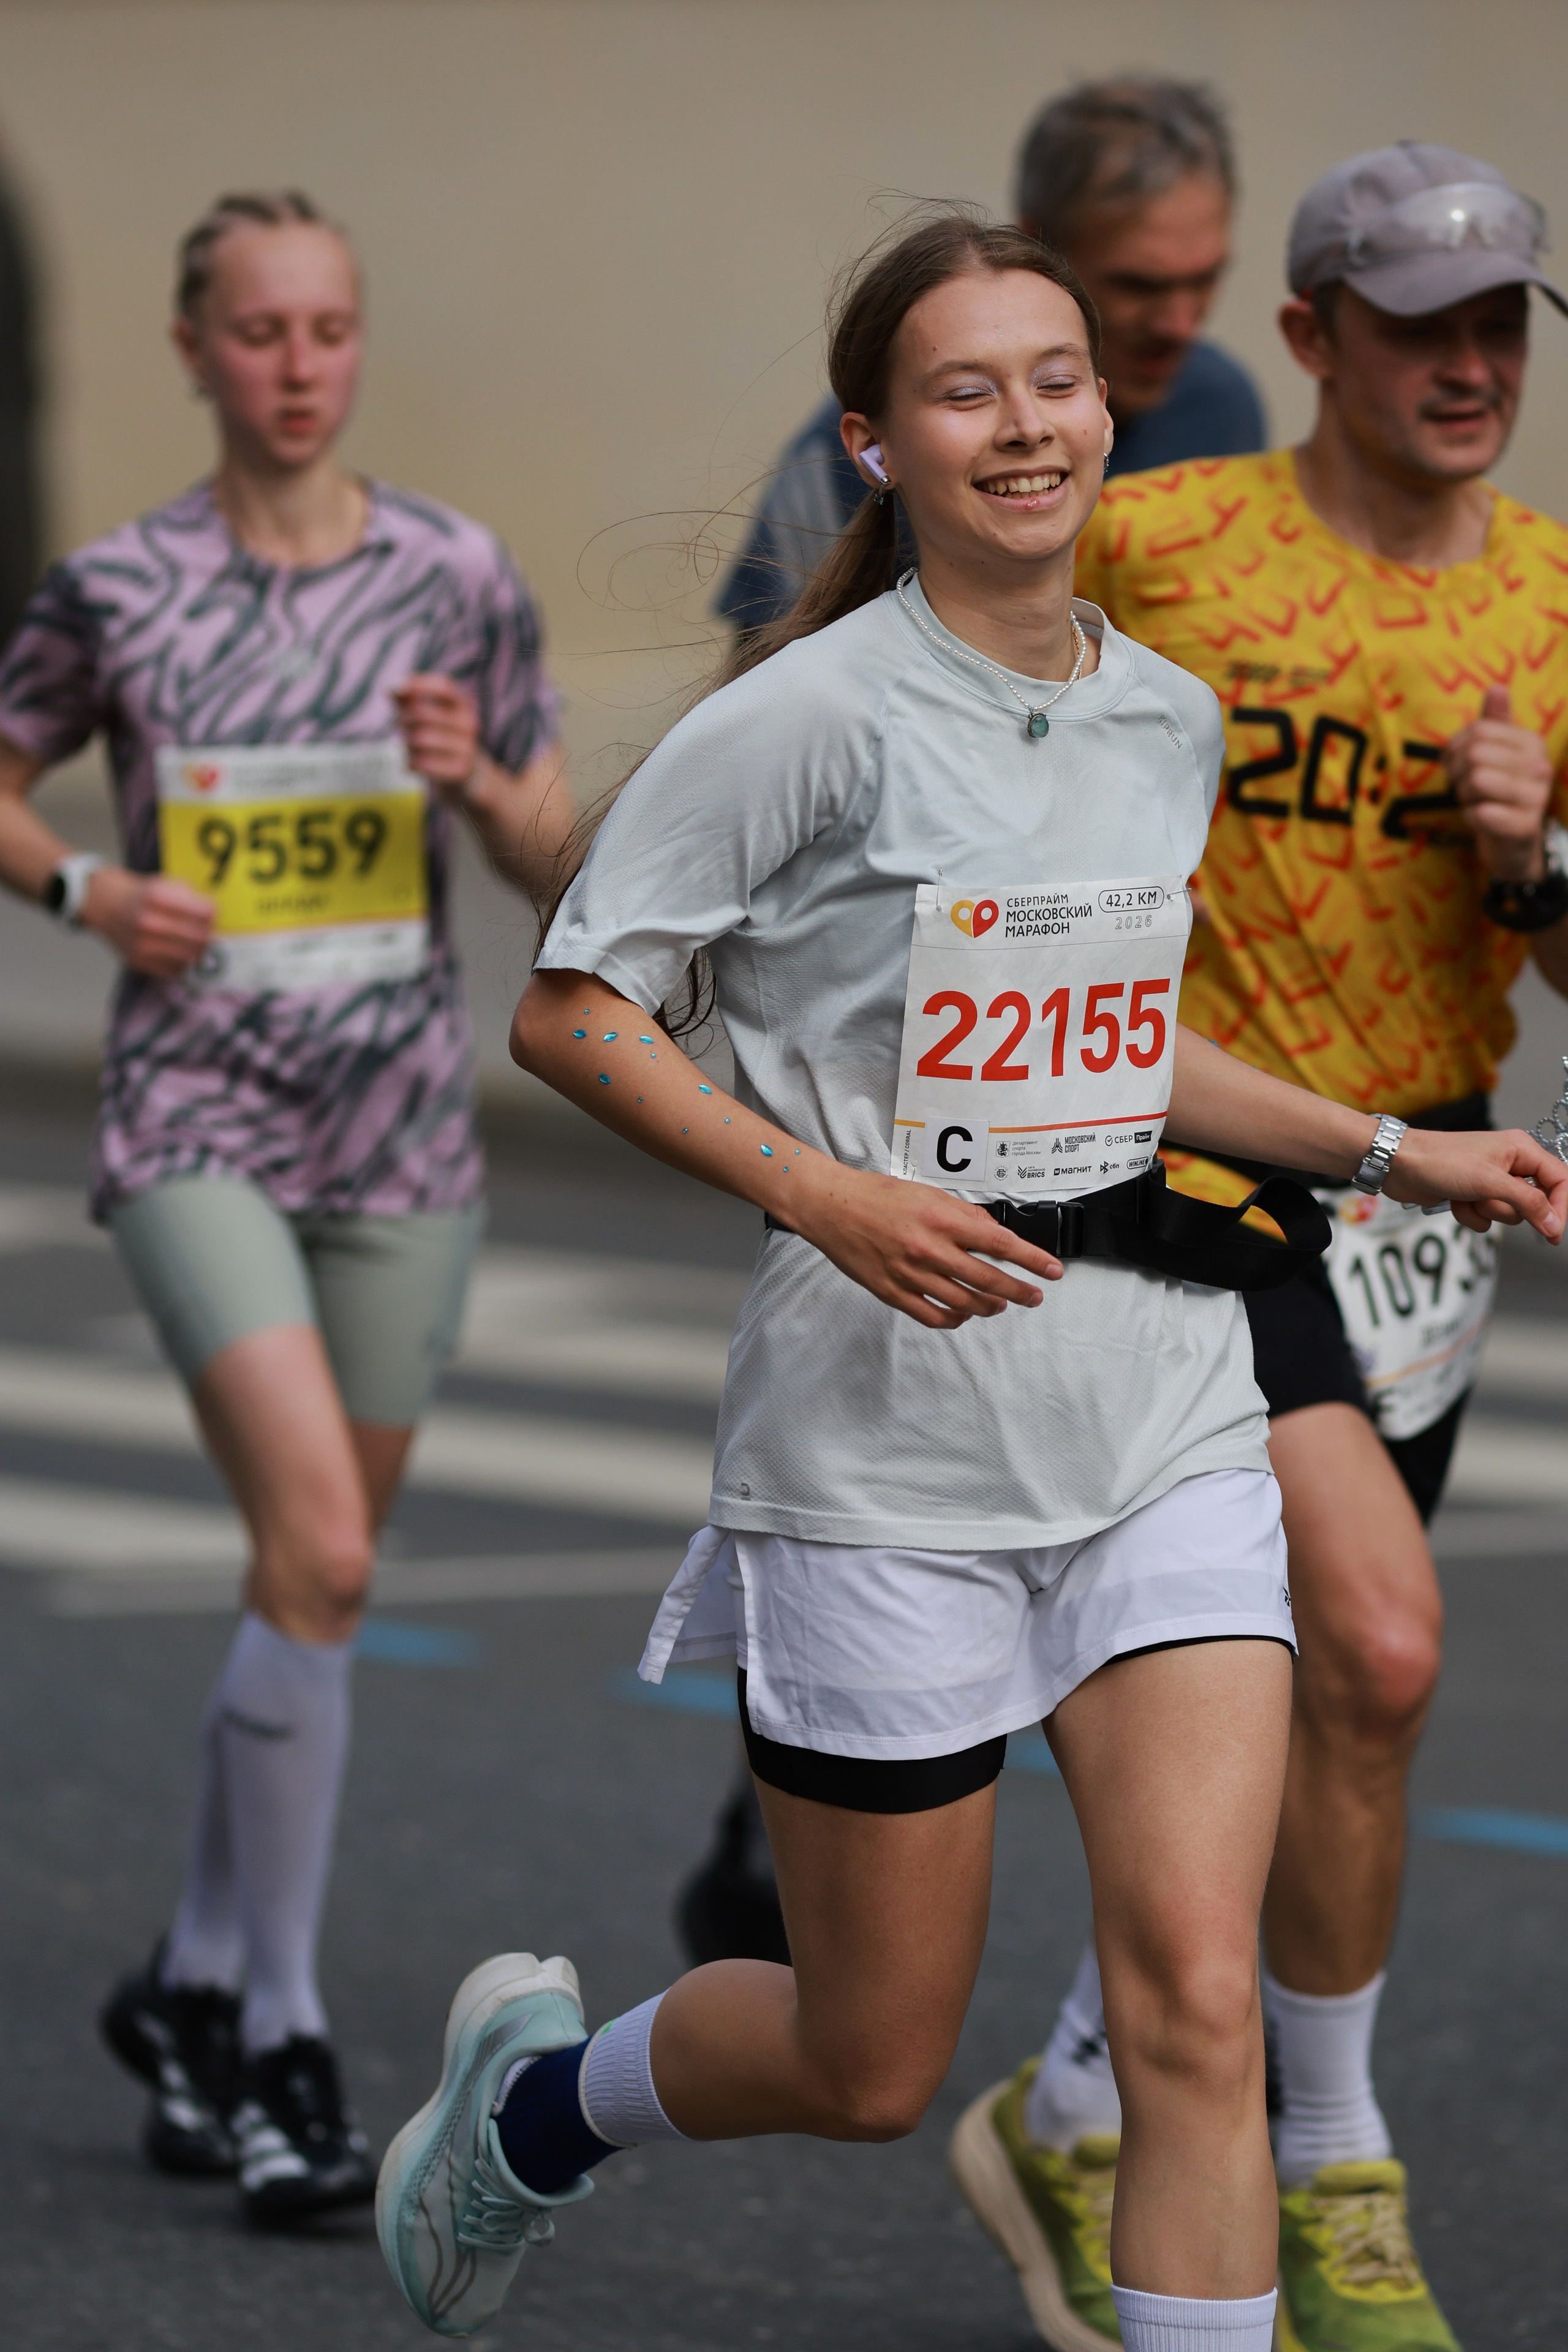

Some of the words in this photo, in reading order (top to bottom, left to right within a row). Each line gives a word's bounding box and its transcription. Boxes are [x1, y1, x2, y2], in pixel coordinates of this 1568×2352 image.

[1158, 715, 1183, 748] KIPRUN
[197, 809, 388, 887] 9559
[1007, 894, 1069, 907] СБЕРПРАЙМ
[1106, 893, 1133, 908] 42,2
[1138, 891, 1157, 905] КМ
[1006, 903, 1093, 923] МОСКОВСКИЙ
[1005, 922, 1070, 938] МАРАФОН
[1115, 914, 1152, 930] 2026
[916, 978, 1170, 1081] 22155
[1065, 1133, 1096, 1144] МОСКОВСКИЙ
[1114, 1135, 1133, 1144] СБЕР
[1136, 1133, 1150, 1142] Прайм
[937, 1125, 973, 1173] C
[1065, 1144, 1080, 1153] СПОРТ
[1349, 1224, 1498, 1327] 1093
